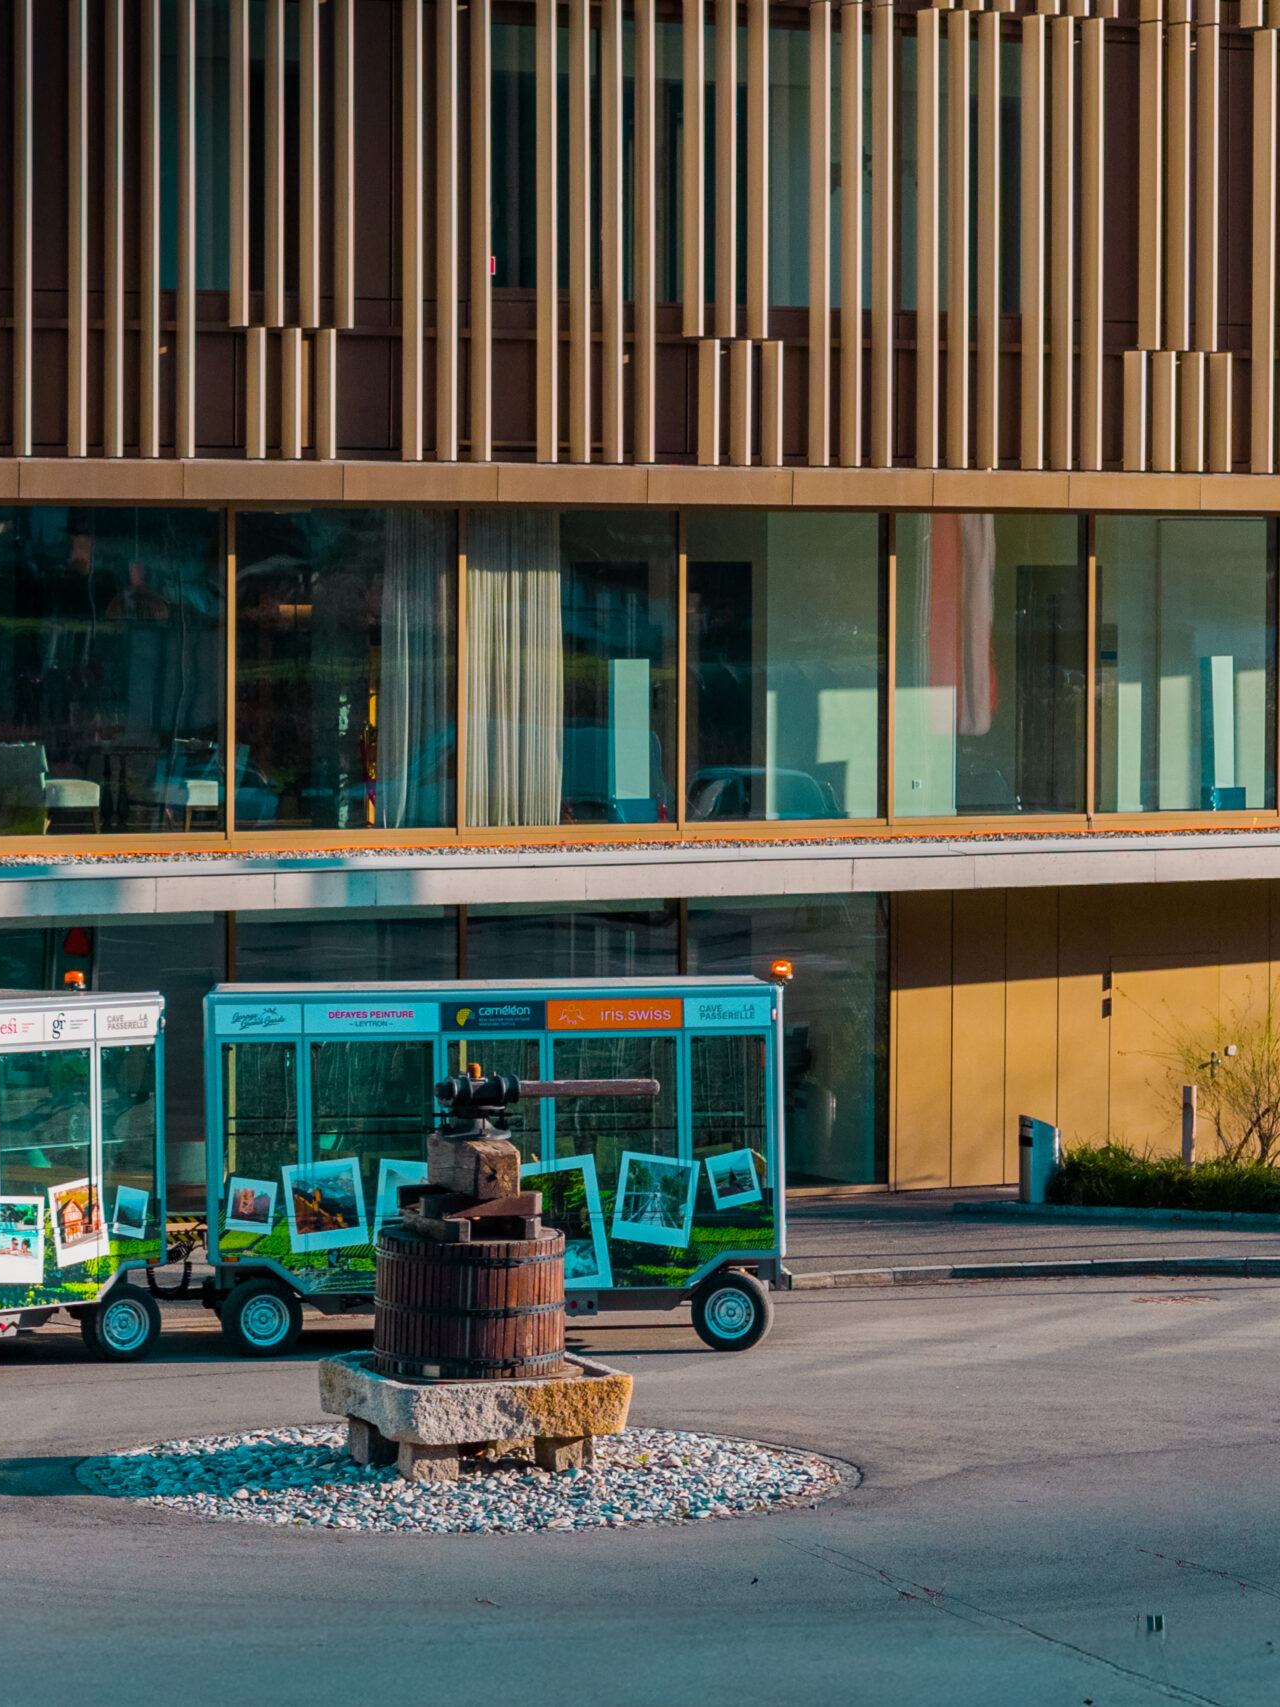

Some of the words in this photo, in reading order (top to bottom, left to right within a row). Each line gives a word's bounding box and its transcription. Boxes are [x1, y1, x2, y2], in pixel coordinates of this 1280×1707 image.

[328, 1008, 368, 1019] DÉFAYES
[370, 1010, 415, 1019] PEINTURE
[478, 1005, 531, 1016] caméléon
[600, 1006, 672, 1021] iris.swiss
[698, 1004, 723, 1013] CAVE
[743, 1004, 755, 1012] LA
[107, 1014, 124, 1023] CAVE
[139, 1013, 148, 1021] LA
[699, 1011, 756, 1021] PASSERELLE
[107, 1020, 148, 1031] PASSERELLE
[354, 1020, 388, 1028] LEYTRON
